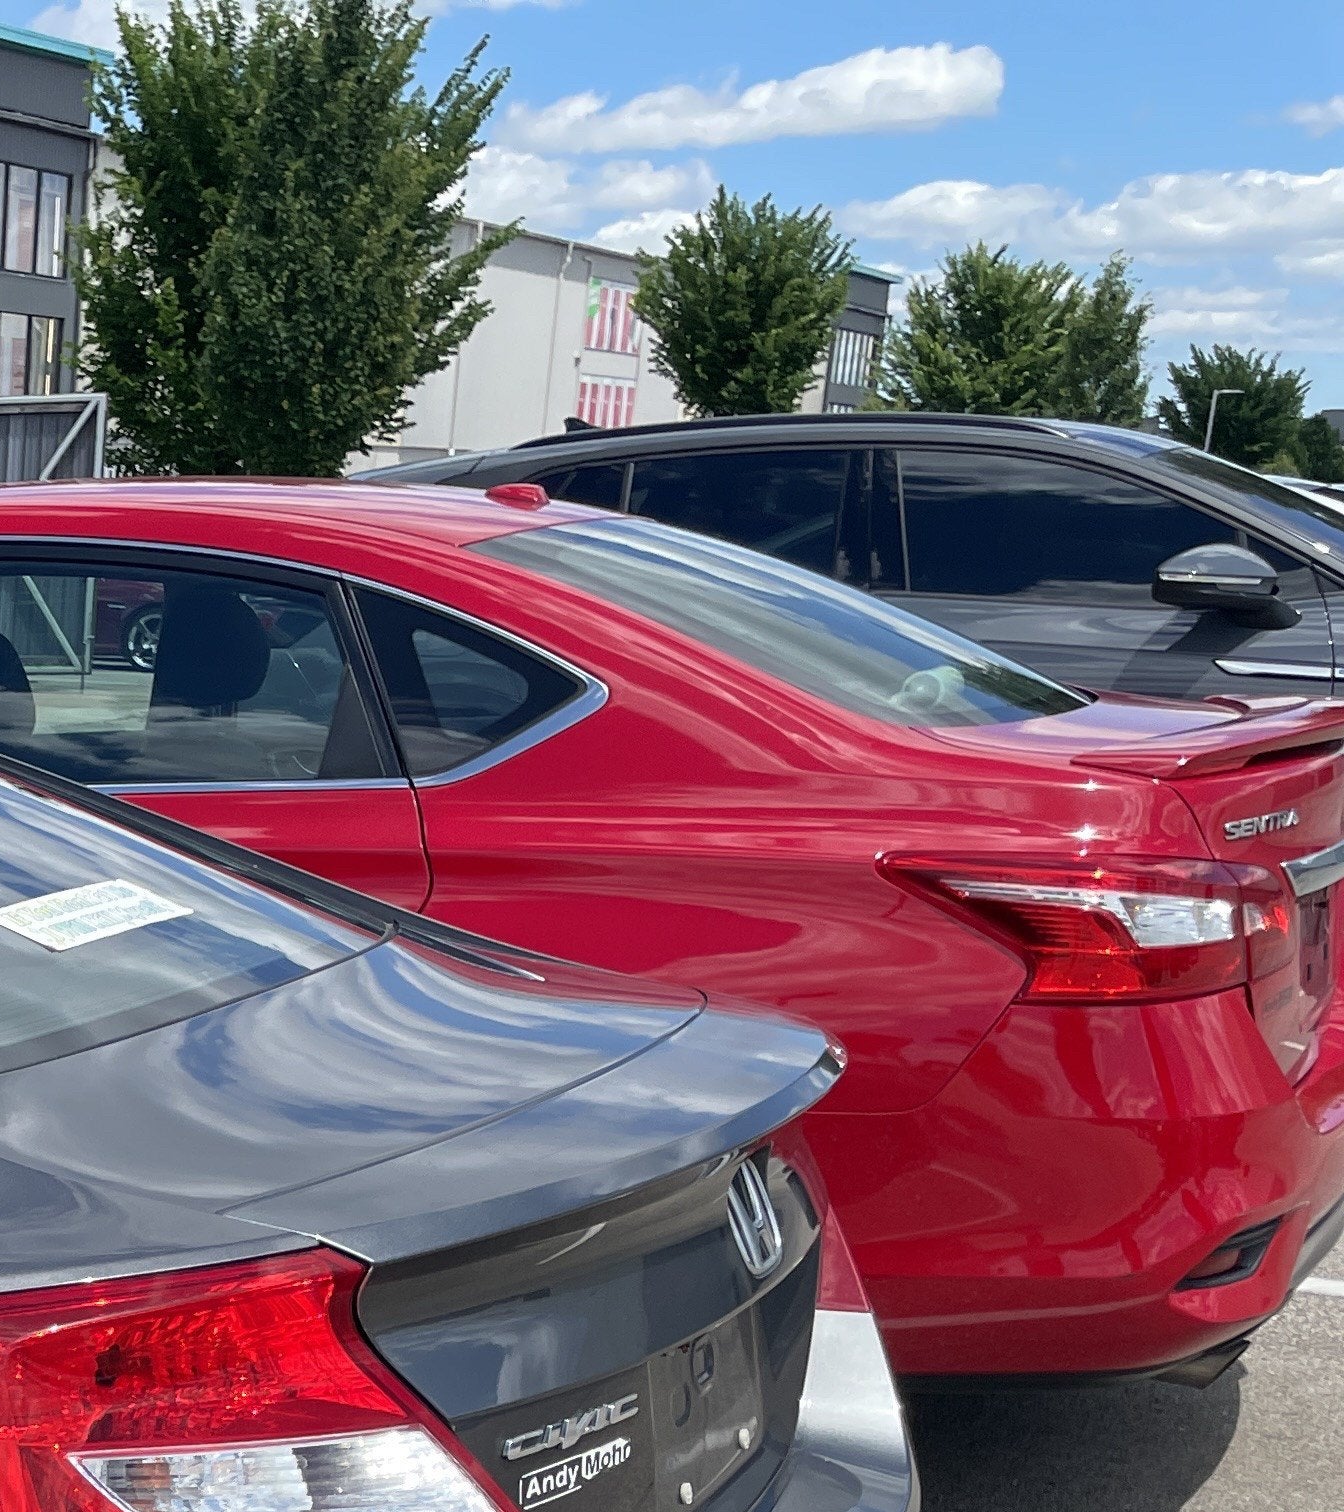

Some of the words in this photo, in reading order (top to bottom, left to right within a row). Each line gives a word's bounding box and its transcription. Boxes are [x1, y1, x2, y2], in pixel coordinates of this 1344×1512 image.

[1224, 808, 1300, 841] SENTRA
[502, 1393, 640, 1461] CIVIC
[525, 1464, 580, 1499] Andy
